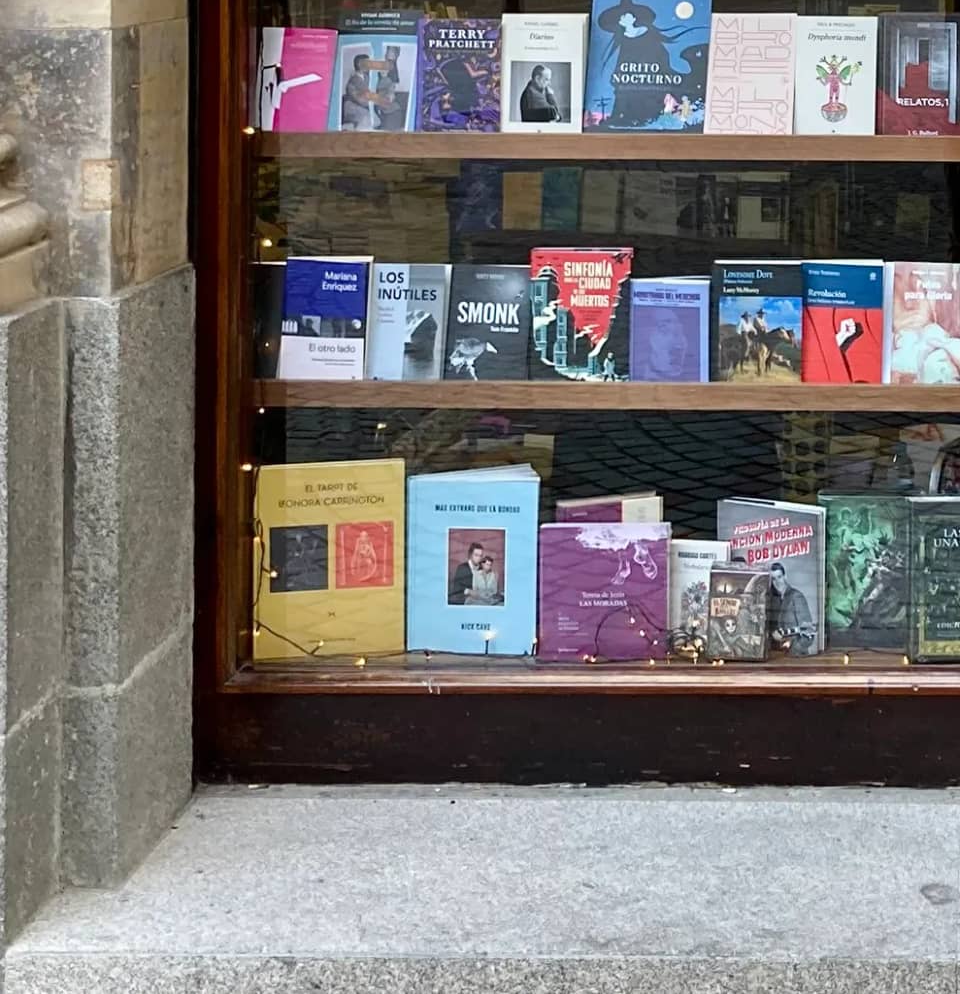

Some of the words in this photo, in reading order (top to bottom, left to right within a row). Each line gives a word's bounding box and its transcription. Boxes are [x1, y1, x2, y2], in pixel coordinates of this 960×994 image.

[439, 29, 486, 39] TERRY
[808, 33, 842, 42] Dysphoria
[429, 39, 496, 49] PRATCHETT
[620, 62, 660, 73] GRITO
[612, 73, 683, 85] NOCTURNO
[563, 260, 613, 277] SINFONÍA
[325, 271, 358, 281] Mariana
[380, 271, 405, 284] LOS
[578, 277, 612, 290] CIUDAD
[378, 286, 438, 301] INÚTILES
[808, 288, 847, 298] Revolución
[570, 294, 609, 307] MUERTOS
[458, 301, 521, 325] SMONK
[309, 343, 316, 352] El
[318, 344, 336, 352] otro
[337, 344, 356, 353] lado
[305, 484, 313, 493] EL
[318, 483, 345, 491] TAROT
[347, 483, 359, 491] DE
[323, 495, 385, 506] CARRINGTON
[730, 533, 764, 550] NCIÓN
[933, 538, 959, 548] UNA
[747, 548, 771, 566] BOB
[772, 540, 810, 560] DYLAN
